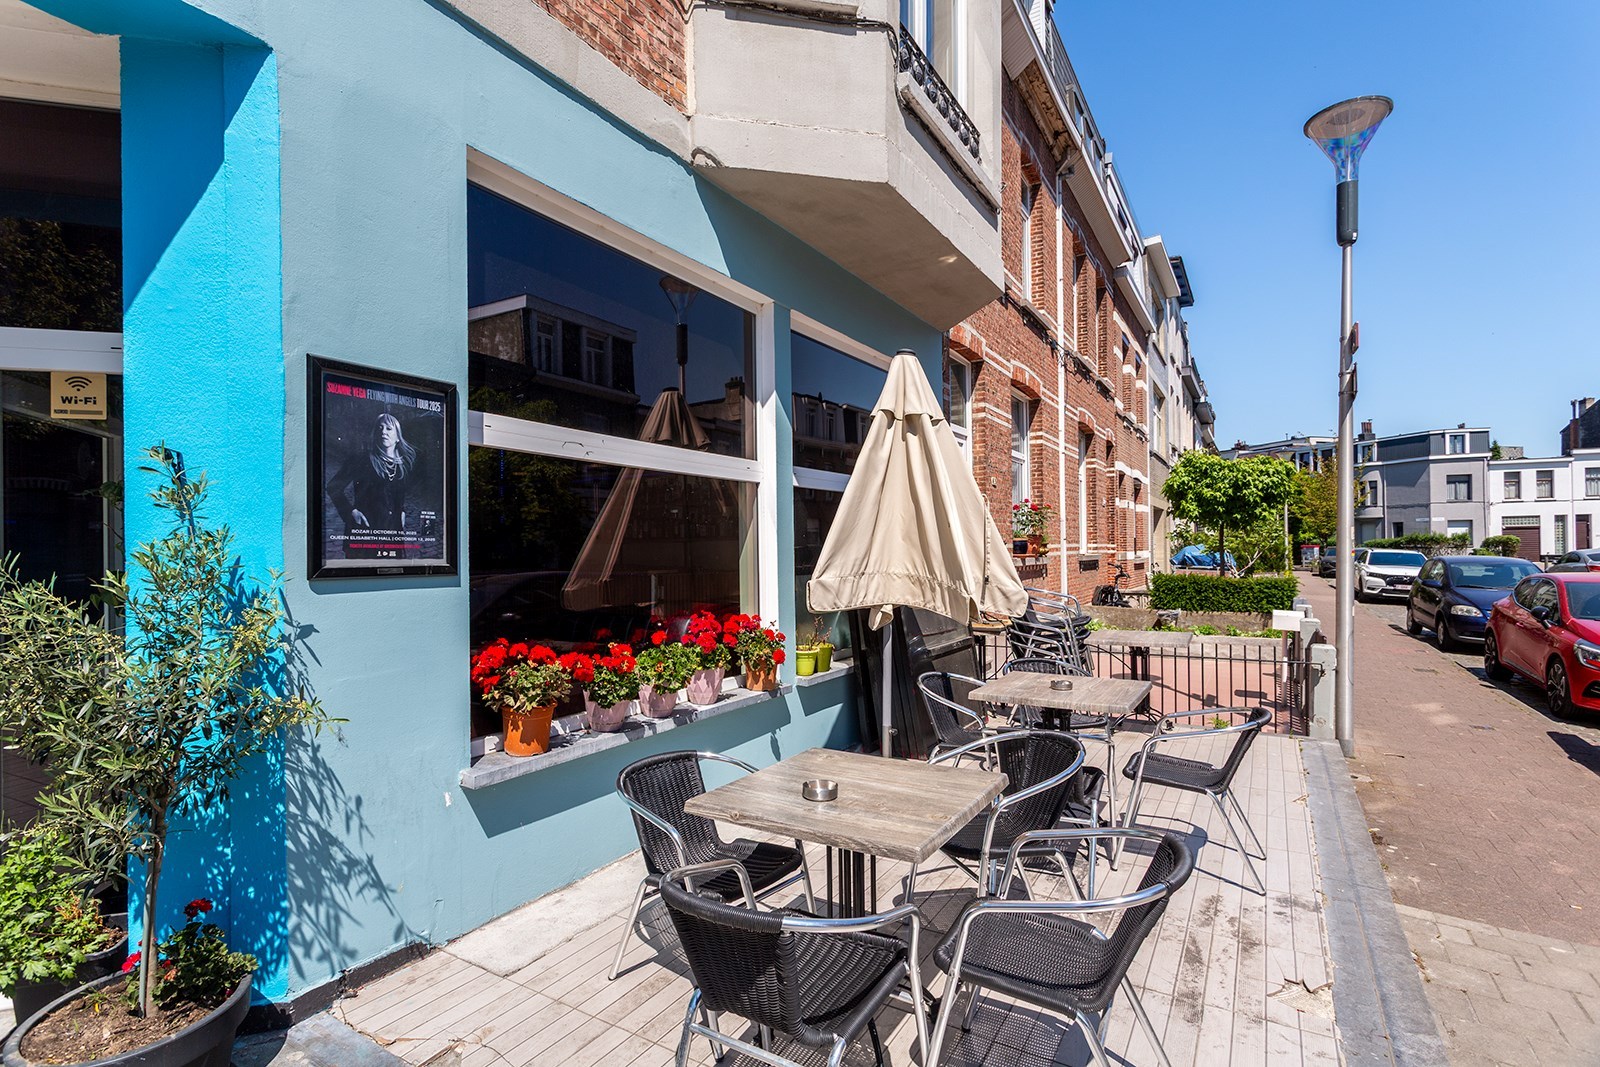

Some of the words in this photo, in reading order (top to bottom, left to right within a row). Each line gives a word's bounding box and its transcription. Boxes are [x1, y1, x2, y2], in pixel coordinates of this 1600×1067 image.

[60, 395, 97, 405] Wi-Fi
[326, 382, 352, 396] SUZANNE
[352, 386, 367, 399] VEGA
[366, 389, 385, 402] FLYING
[385, 392, 398, 404] WITH
[398, 394, 416, 407] ANGELS
[416, 398, 429, 410] TOUR
[429, 401, 441, 412] 2025
